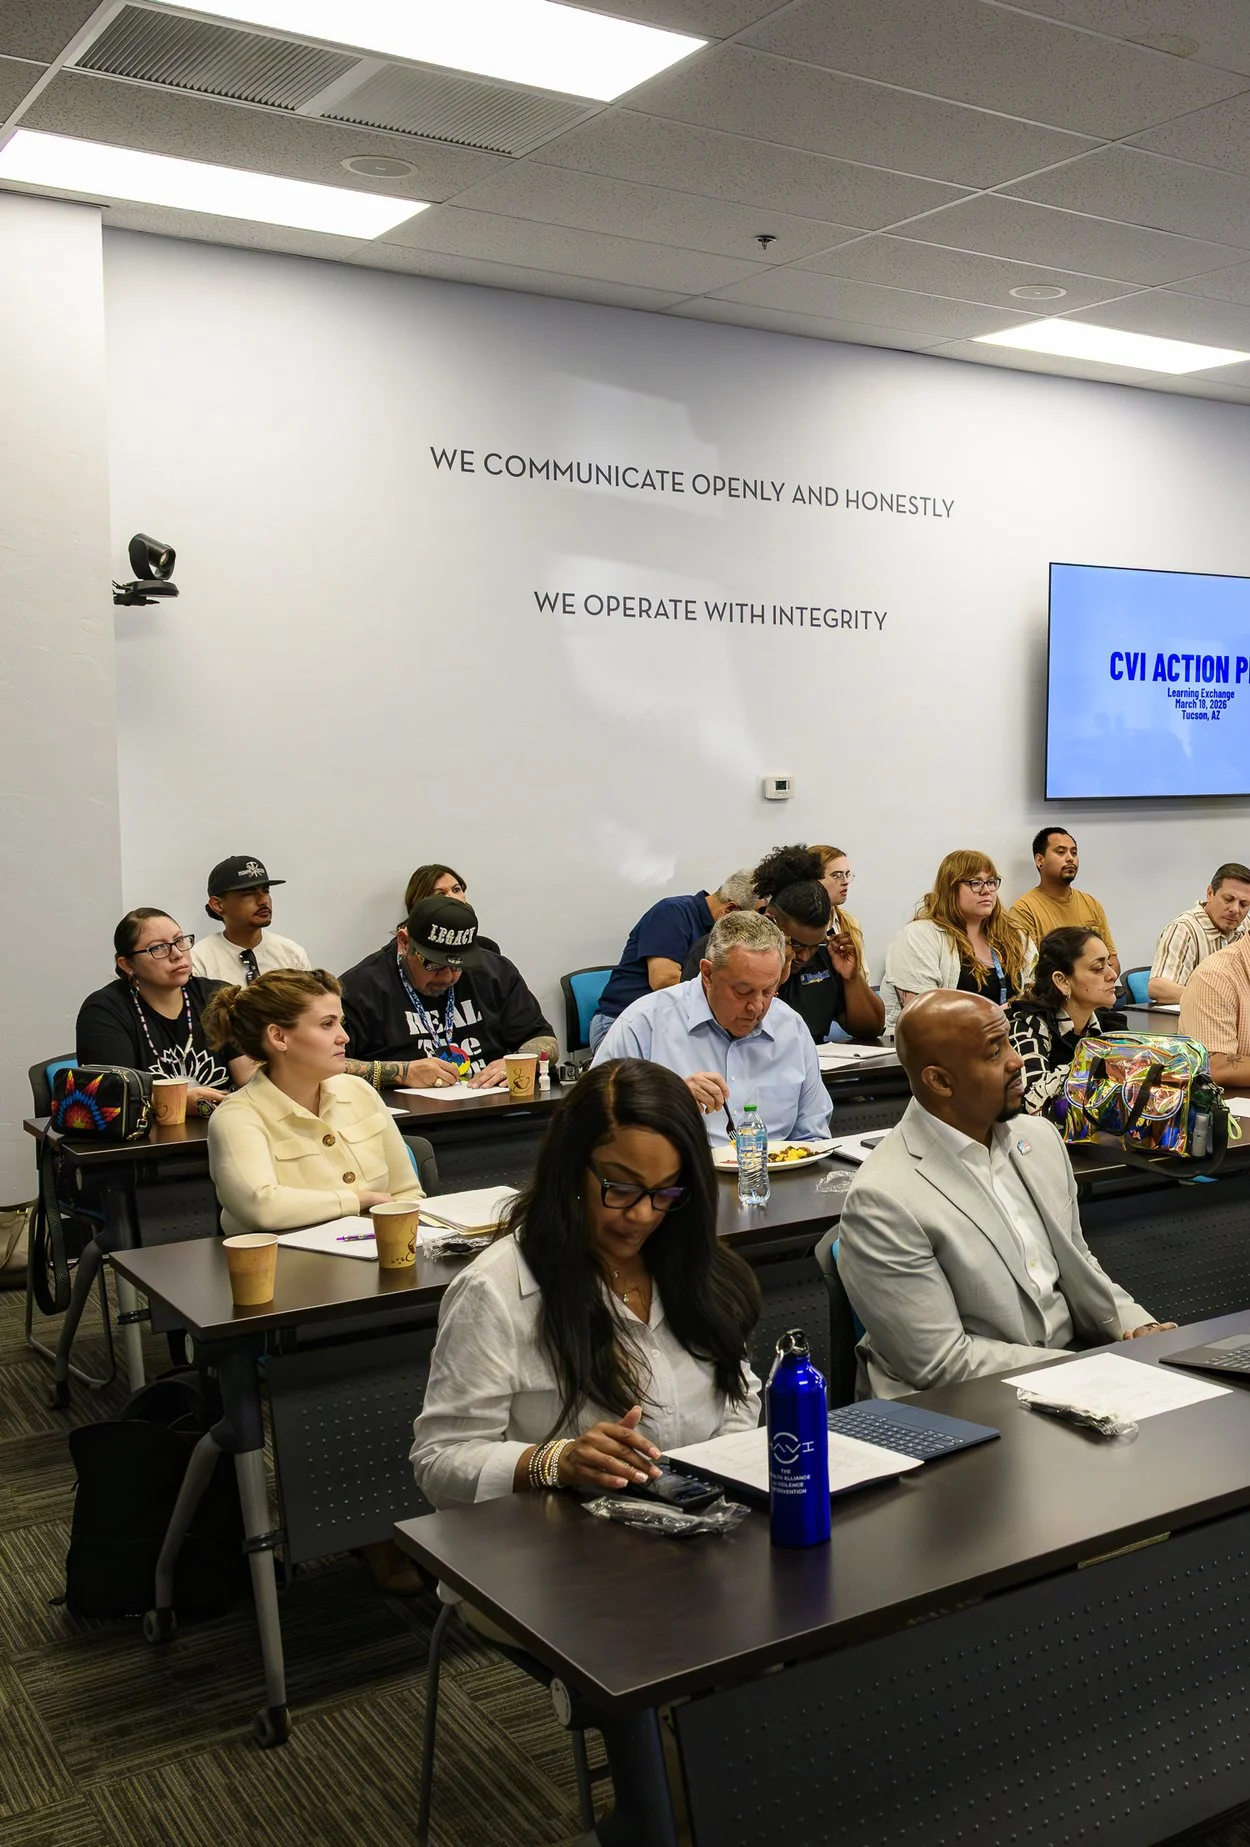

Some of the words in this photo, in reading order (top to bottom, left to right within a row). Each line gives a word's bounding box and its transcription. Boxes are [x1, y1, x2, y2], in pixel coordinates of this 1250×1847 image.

[430, 446, 475, 472] WE
[483, 452, 685, 493] COMMUNICATE
[692, 473, 785, 502] OPENLY
[792, 485, 839, 507] AND
[845, 489, 955, 518] HONESTLY
[534, 591, 576, 615] WE
[584, 594, 697, 621] OPERATE
[704, 600, 765, 624] WITH
[773, 605, 888, 631] INTEGRITY
[1110, 652, 1146, 681] CVI
[1152, 653, 1229, 683] ACTION
[1168, 688, 1199, 700] Learning
[1201, 688, 1235, 700] Exchange
[1175, 699, 1197, 709] March
[1199, 699, 1208, 711] 18,
[1210, 700, 1227, 710] 2026
[1182, 710, 1209, 722] Tucson,
[1211, 711, 1220, 720] AZ
[427, 923, 476, 946] LEGACY
